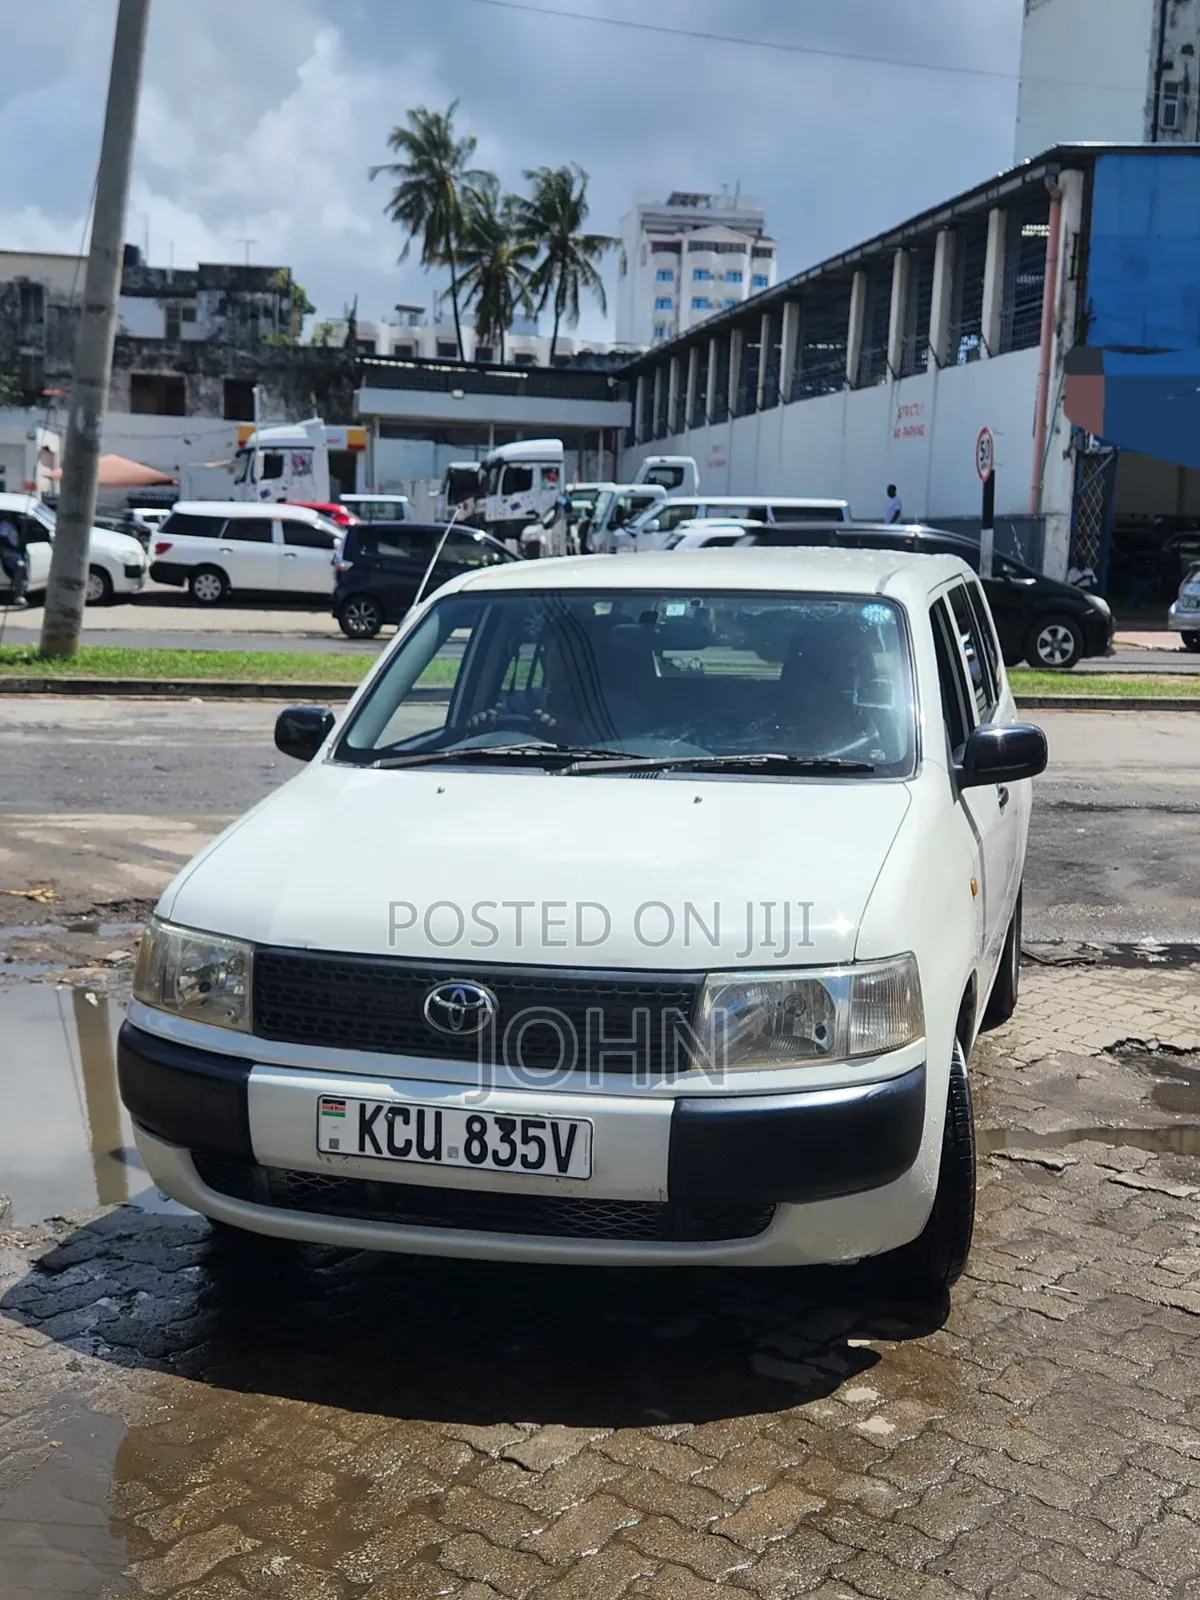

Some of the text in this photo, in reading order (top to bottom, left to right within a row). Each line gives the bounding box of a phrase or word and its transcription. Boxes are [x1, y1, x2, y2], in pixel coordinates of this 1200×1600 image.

[980, 438, 990, 462] 50
[358, 1102, 443, 1161] KCU
[463, 1114, 578, 1173] 835V
